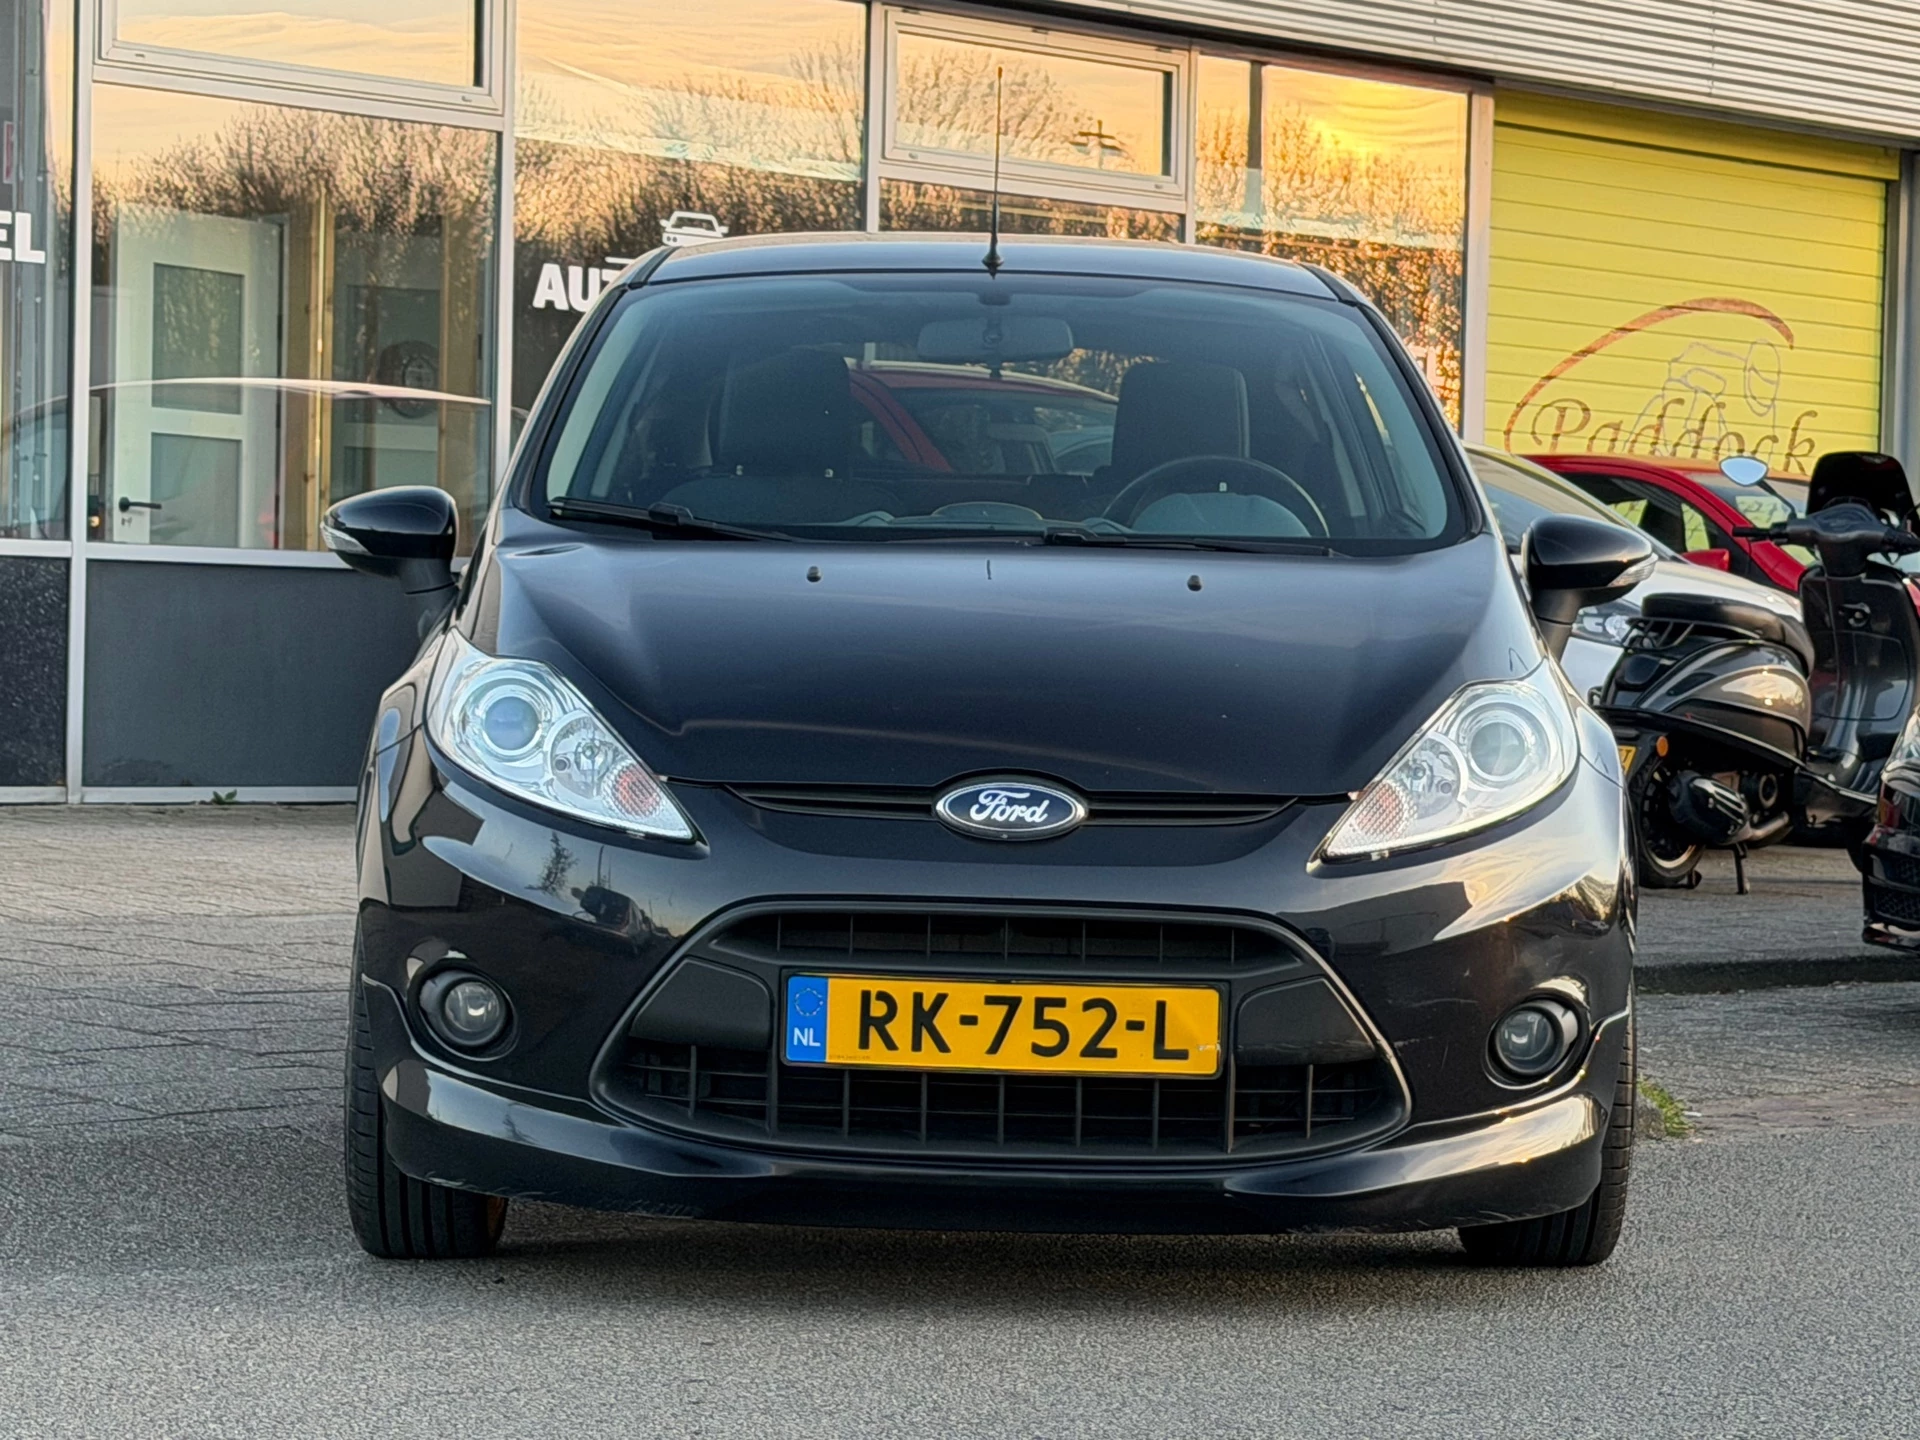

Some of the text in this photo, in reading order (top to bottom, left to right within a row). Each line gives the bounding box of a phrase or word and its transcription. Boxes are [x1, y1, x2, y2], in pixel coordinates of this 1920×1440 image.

[969, 789, 1050, 823] Ford
[793, 1025, 822, 1047] NL
[857, 989, 1190, 1061] RK-752-L
